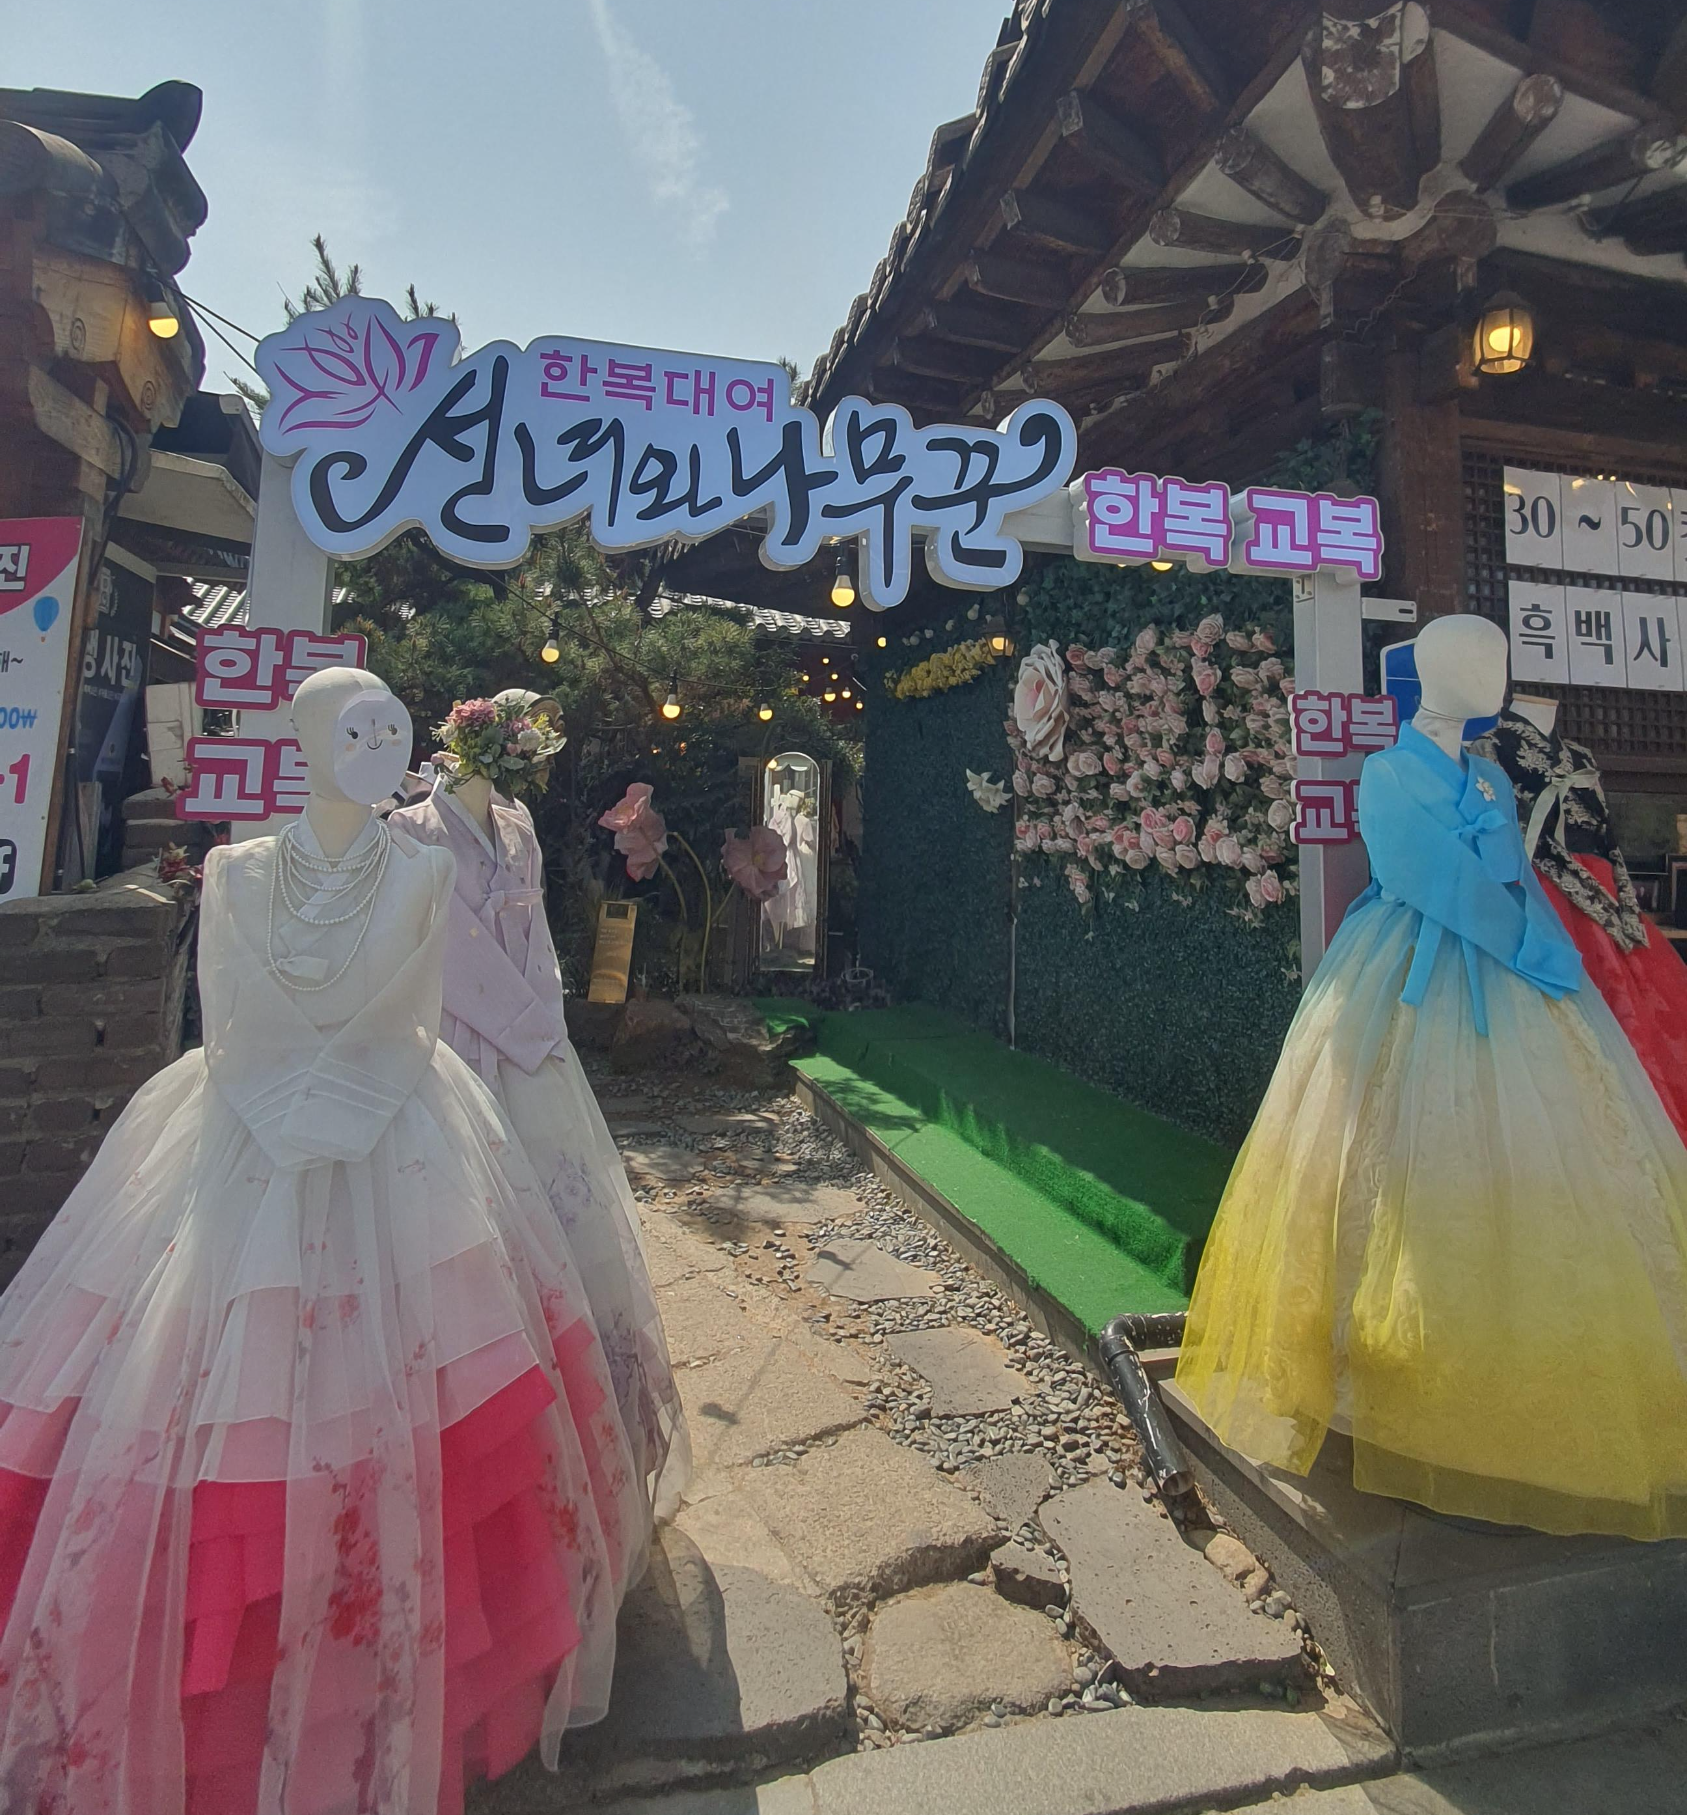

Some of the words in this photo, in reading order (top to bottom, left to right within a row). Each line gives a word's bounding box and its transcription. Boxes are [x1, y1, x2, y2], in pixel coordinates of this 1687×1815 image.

[539, 349, 775, 423] 한복대여
[1090, 475, 1228, 561] 한복
[1250, 494, 1378, 575] 교복
[1297, 696, 1397, 753] 한복
[1299, 785, 1361, 839] 교
